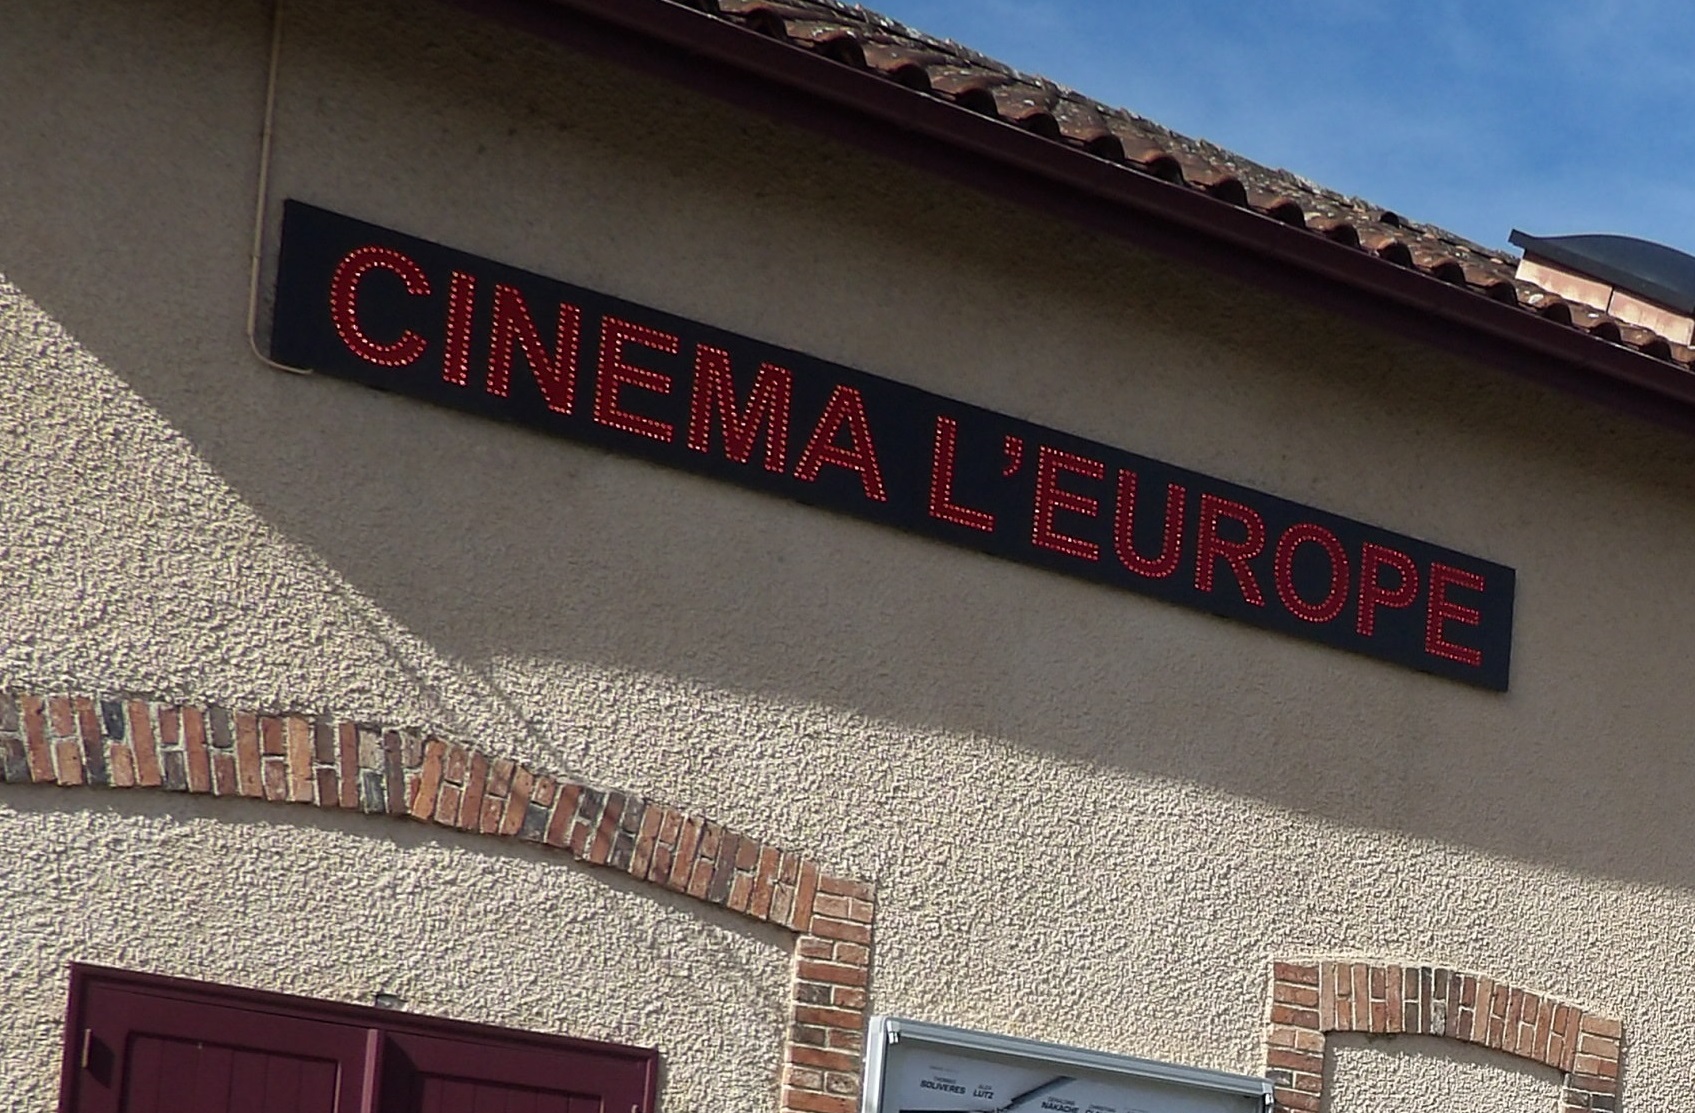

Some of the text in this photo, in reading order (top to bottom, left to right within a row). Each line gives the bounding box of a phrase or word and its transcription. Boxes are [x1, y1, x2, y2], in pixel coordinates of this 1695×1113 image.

[330, 245, 1485, 667] CINEMA L'EUROPE
[920, 1079, 995, 1100] SOLIVERES LUTZ
